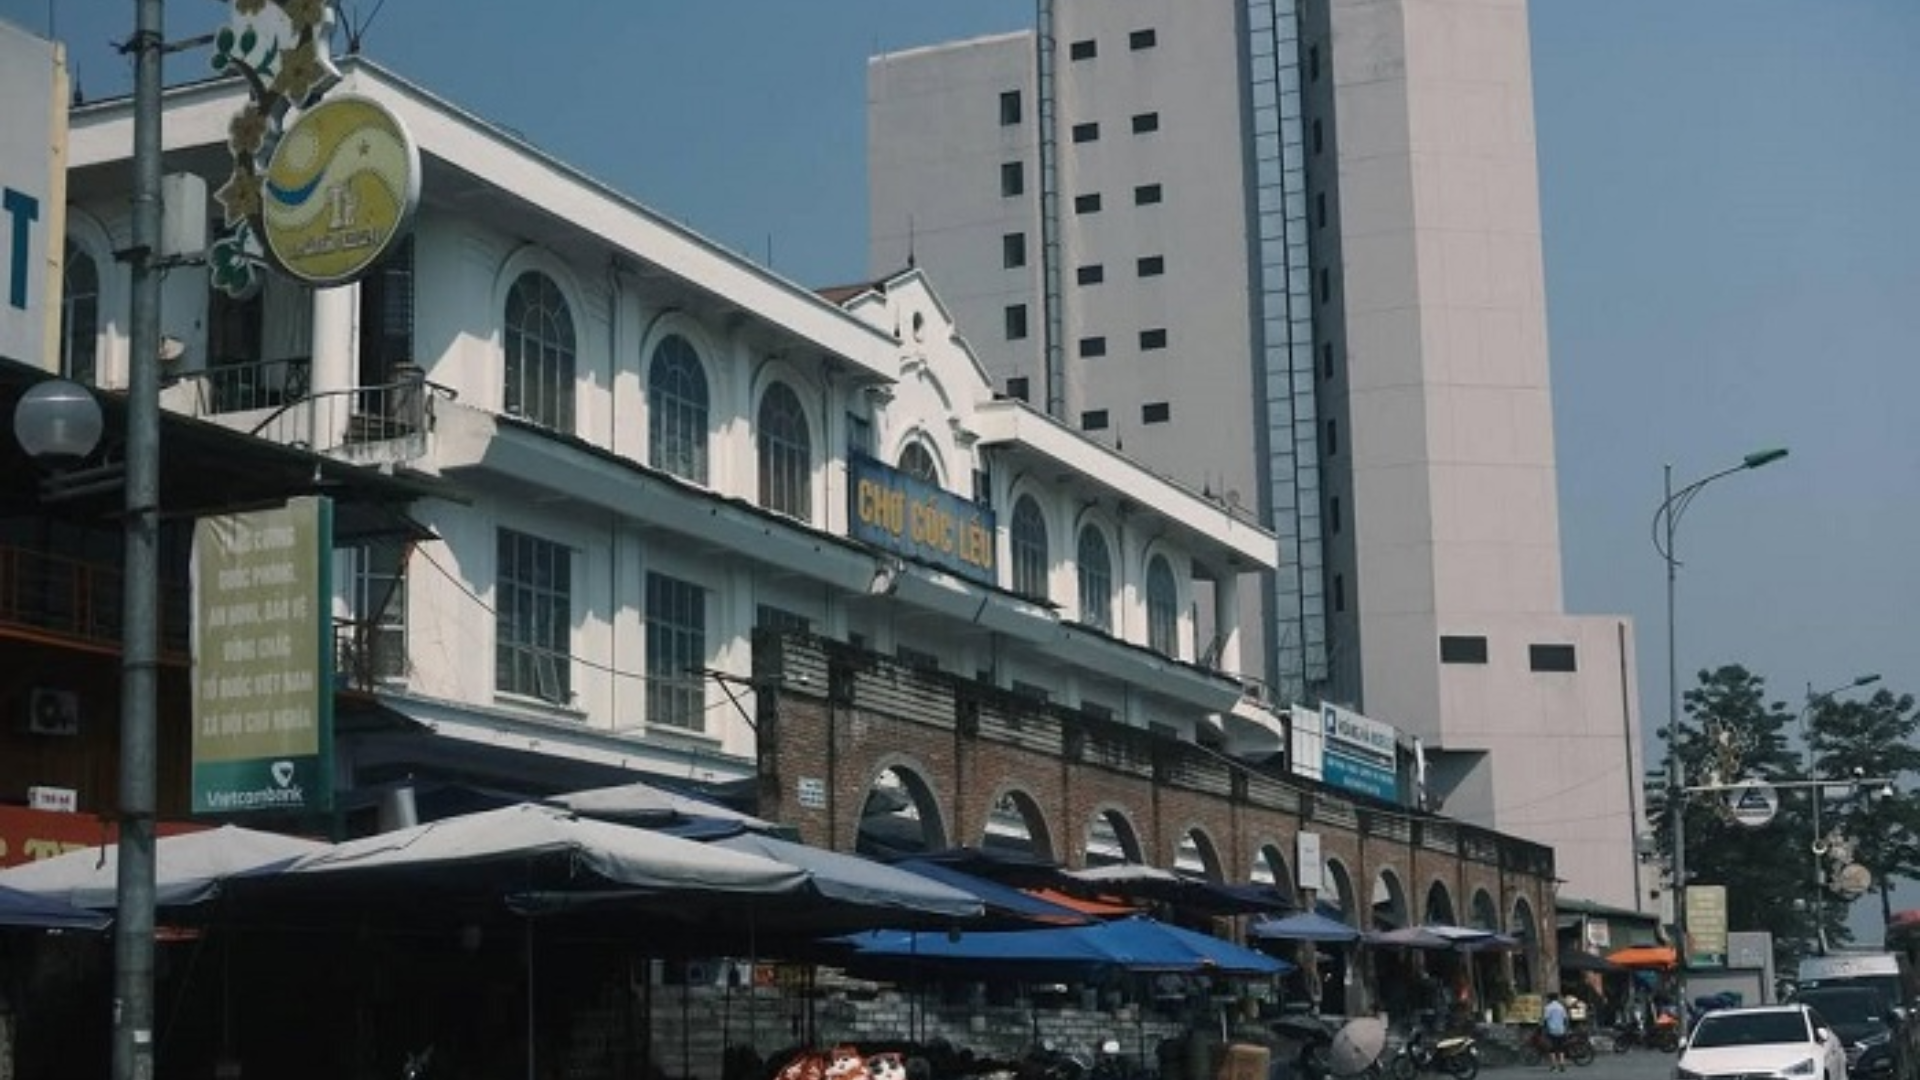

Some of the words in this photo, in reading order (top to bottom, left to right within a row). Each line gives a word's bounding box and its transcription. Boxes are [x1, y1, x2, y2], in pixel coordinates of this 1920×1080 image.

[858, 478, 906, 541] CHỢ
[910, 496, 953, 553] CỐC
[207, 784, 303, 807] Vietcombank
